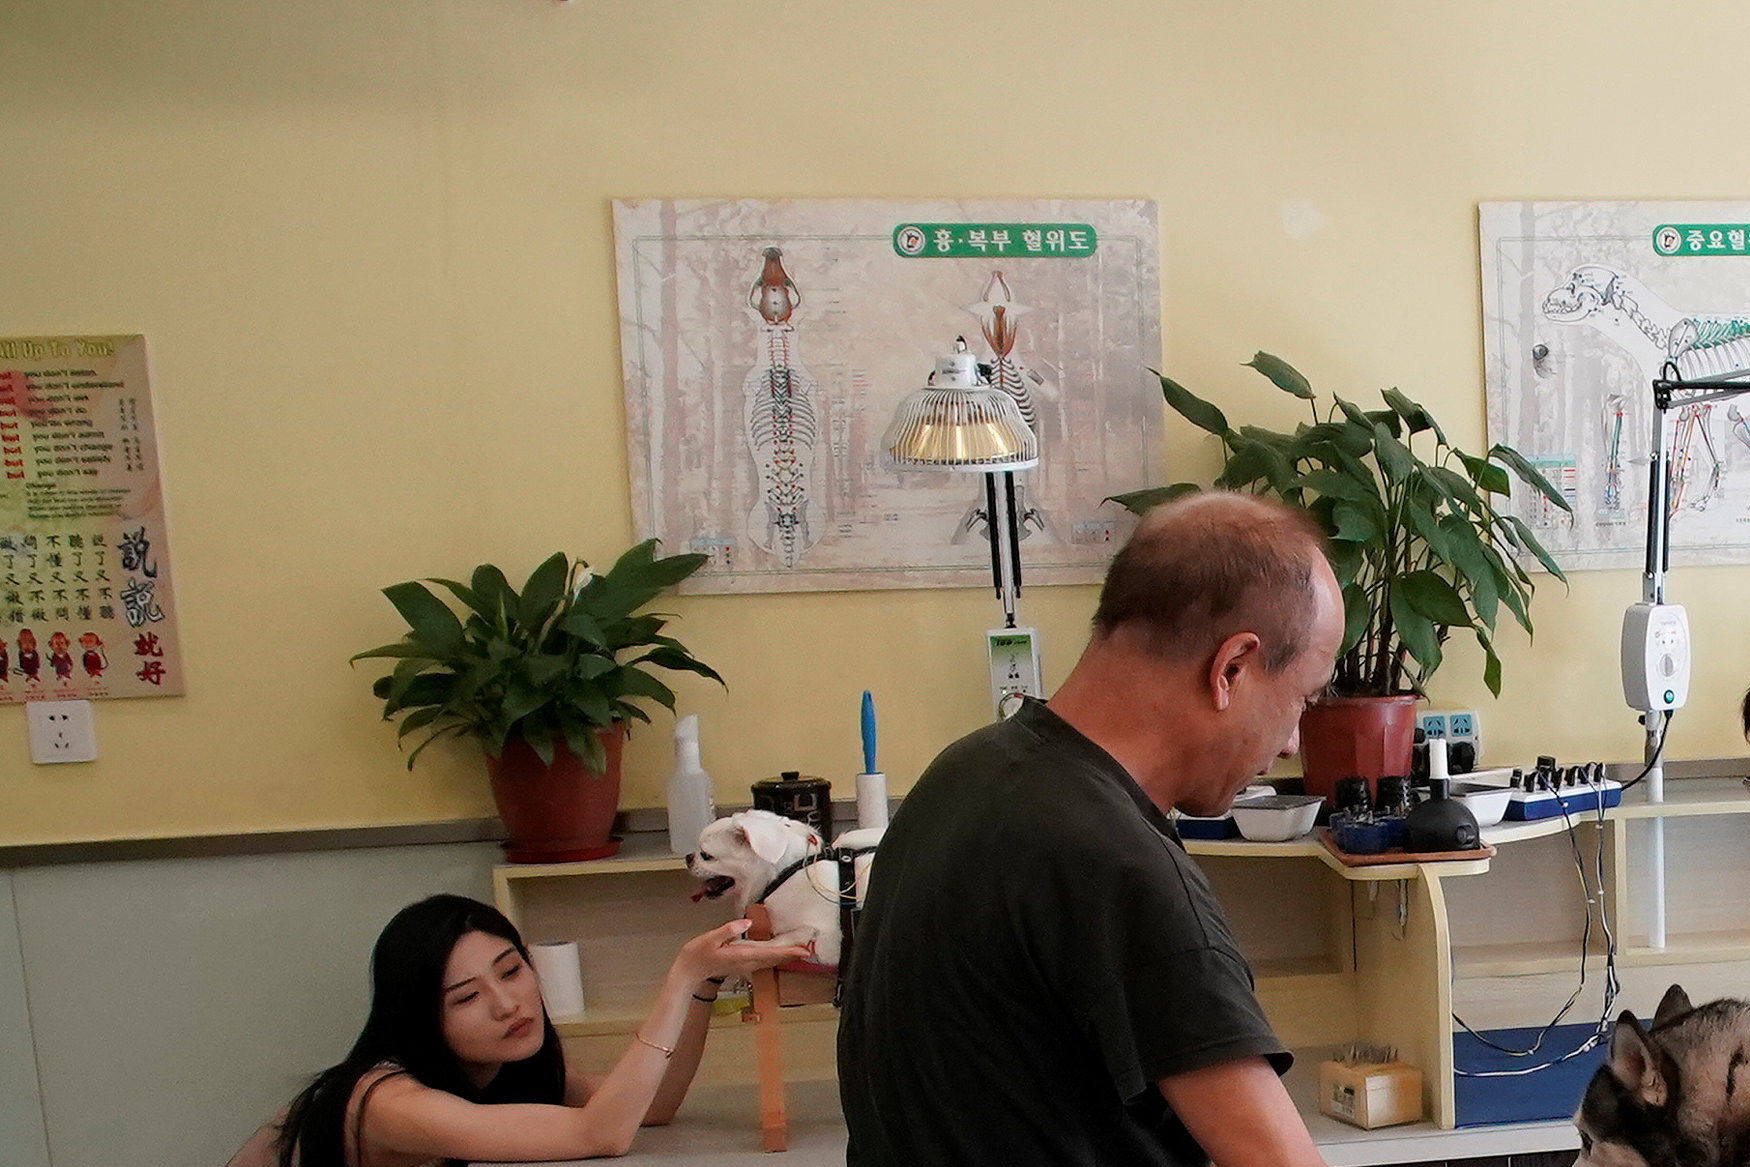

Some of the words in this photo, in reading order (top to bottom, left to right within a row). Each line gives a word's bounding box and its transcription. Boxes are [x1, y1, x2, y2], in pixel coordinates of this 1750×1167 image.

[1022, 228, 1090, 253] 혈위도
[1, 421, 18, 430] but
[1, 433, 20, 442] but
[3, 446, 22, 454] but
[4, 458, 24, 467] but
[6, 470, 25, 479] but
